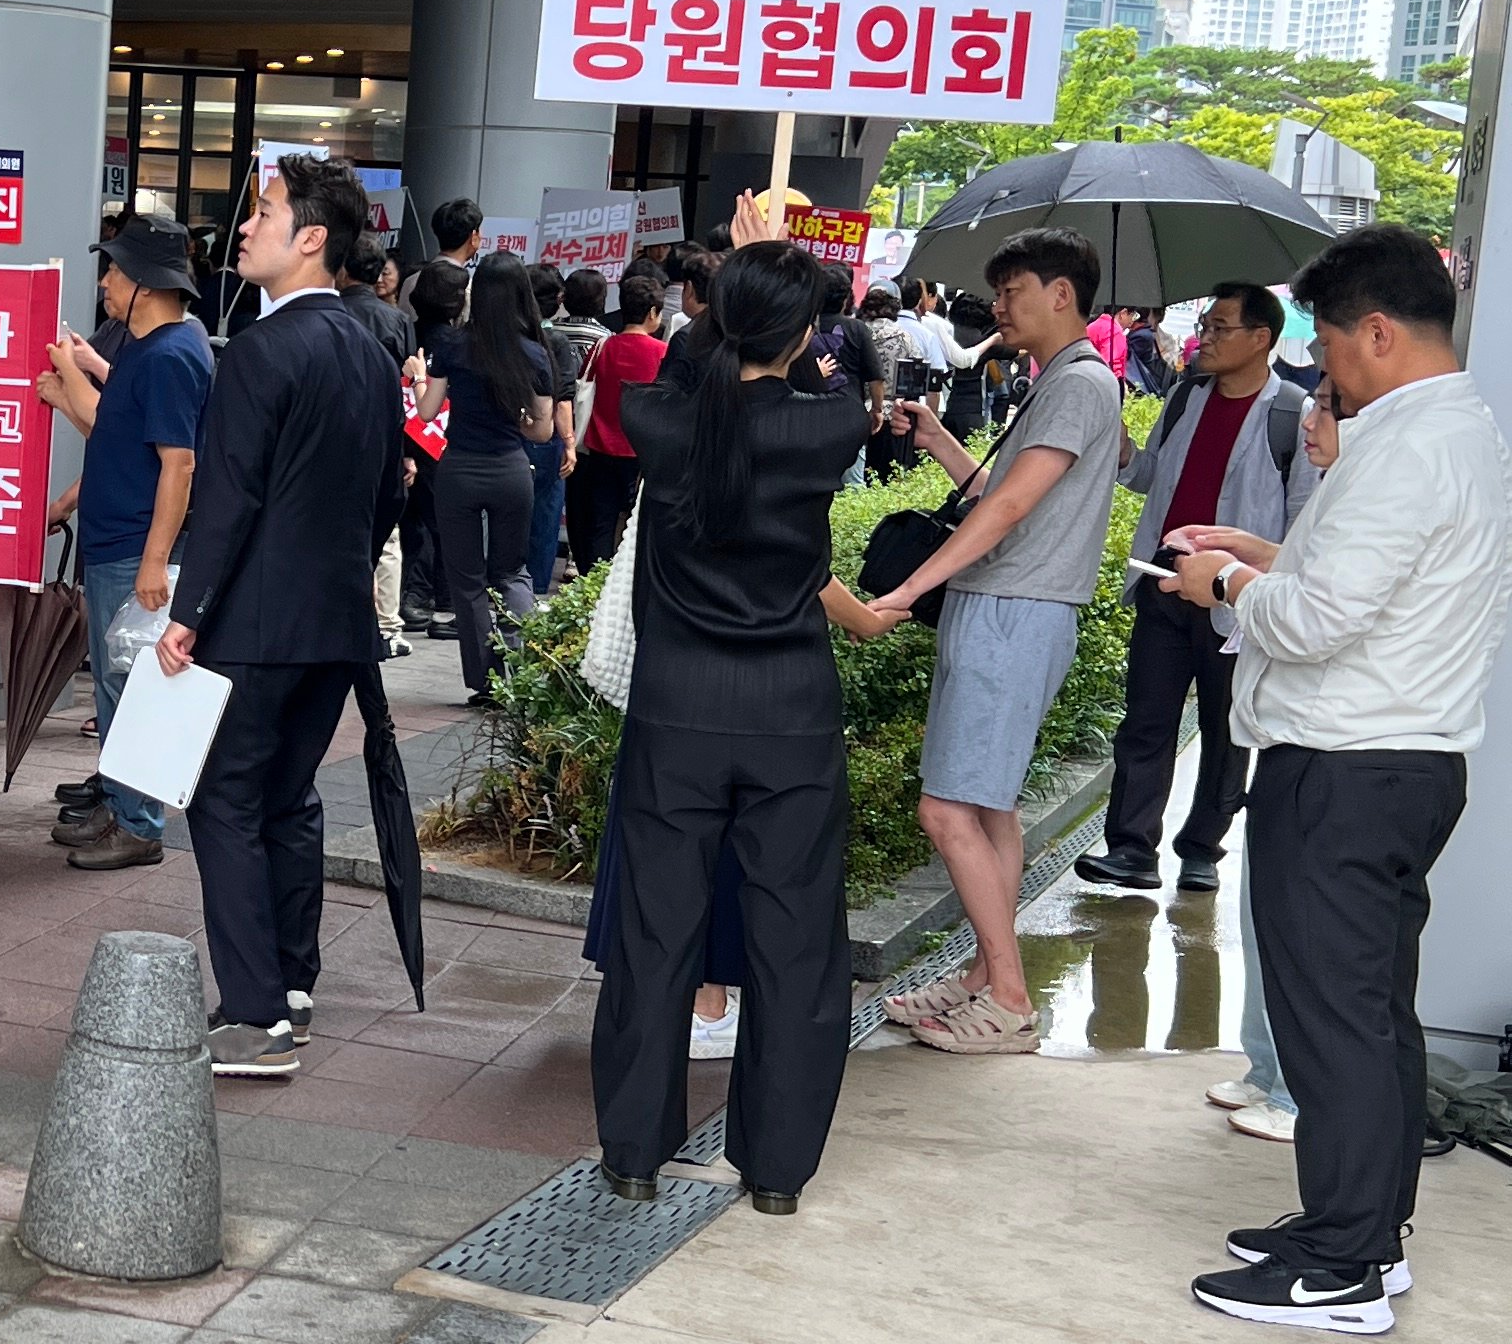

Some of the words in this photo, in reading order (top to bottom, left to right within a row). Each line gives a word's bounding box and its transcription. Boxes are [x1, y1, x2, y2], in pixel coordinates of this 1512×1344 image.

[543, 203, 632, 238] 국민의힘
[496, 235, 528, 253] 함께
[541, 232, 628, 268] 선수교체
[790, 237, 861, 263] 원협의회
